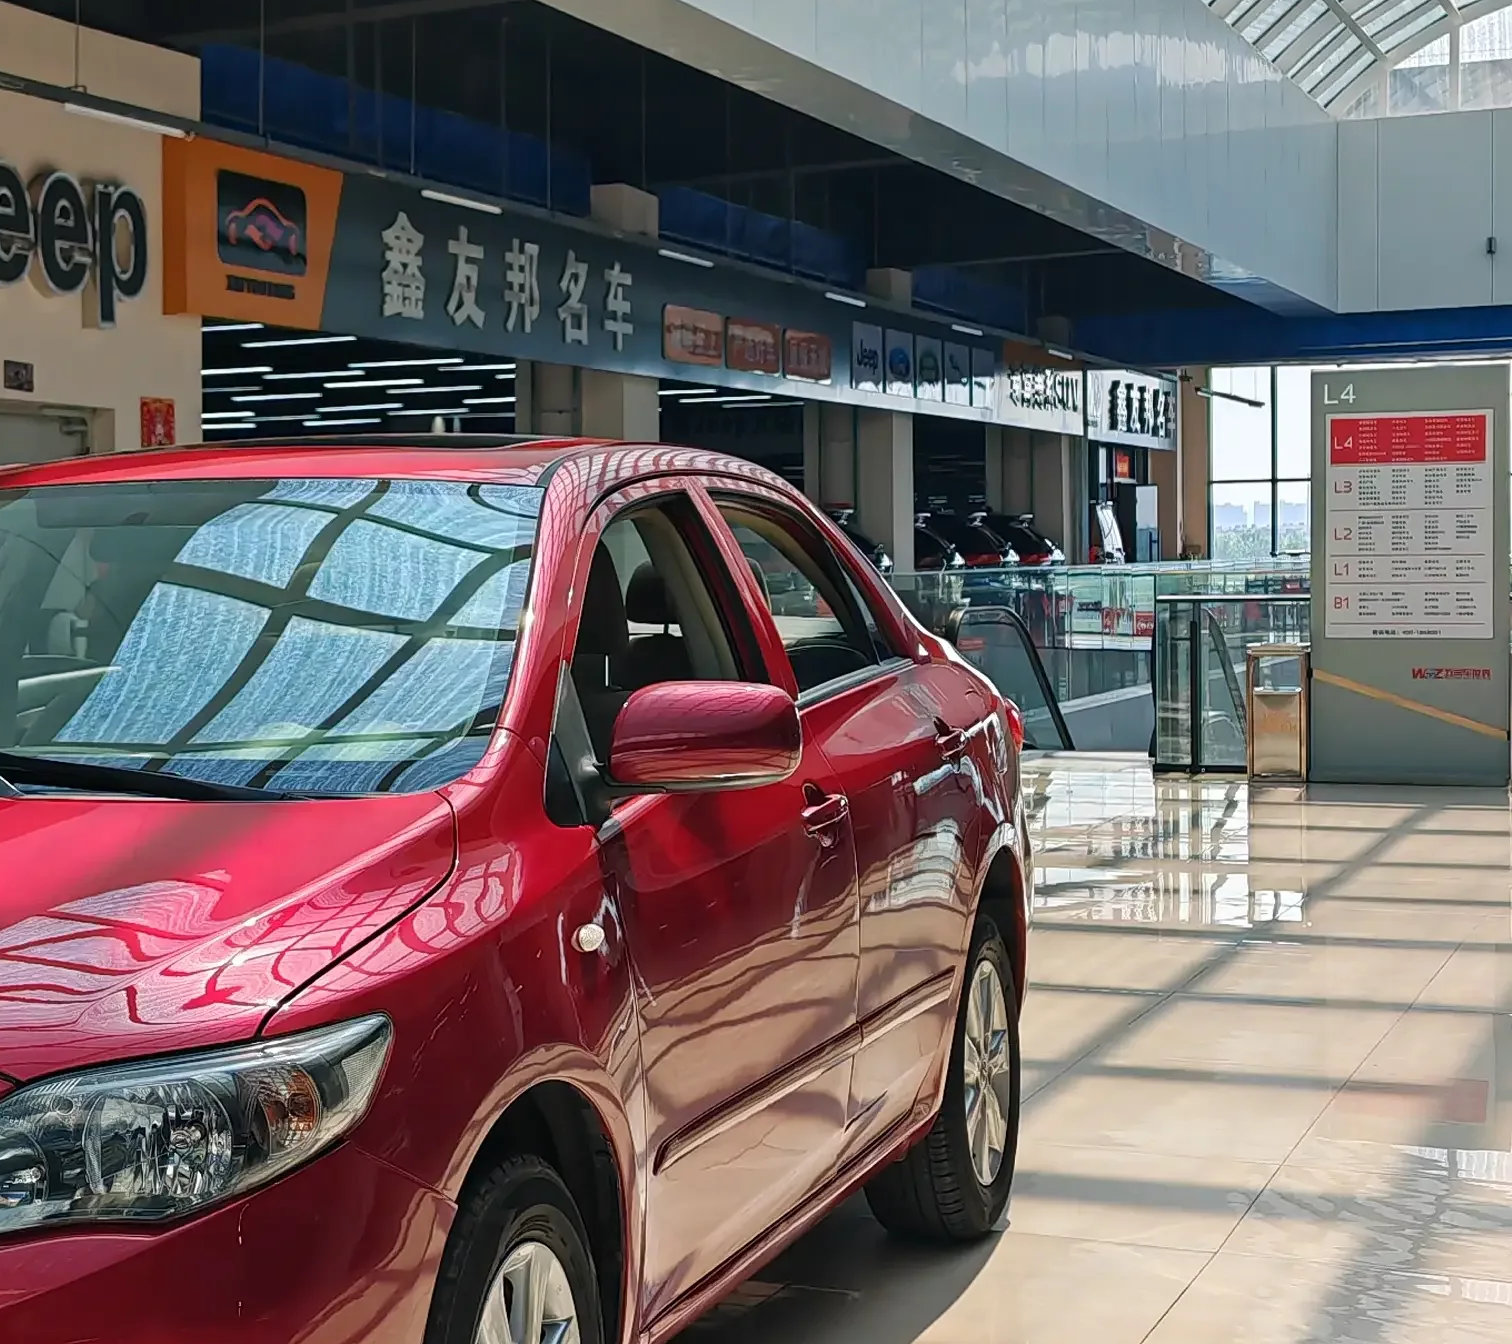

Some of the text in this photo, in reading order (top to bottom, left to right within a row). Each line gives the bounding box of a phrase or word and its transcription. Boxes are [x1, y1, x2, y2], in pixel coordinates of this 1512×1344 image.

[380, 210, 635, 353] 鑫友邦名车
[1324, 384, 1357, 404] L4
[1334, 436, 1353, 450] L4
[1334, 480, 1353, 494] L3
[1334, 527, 1353, 541] L2
[1334, 563, 1350, 576] L1
[1334, 596, 1350, 610] B1
